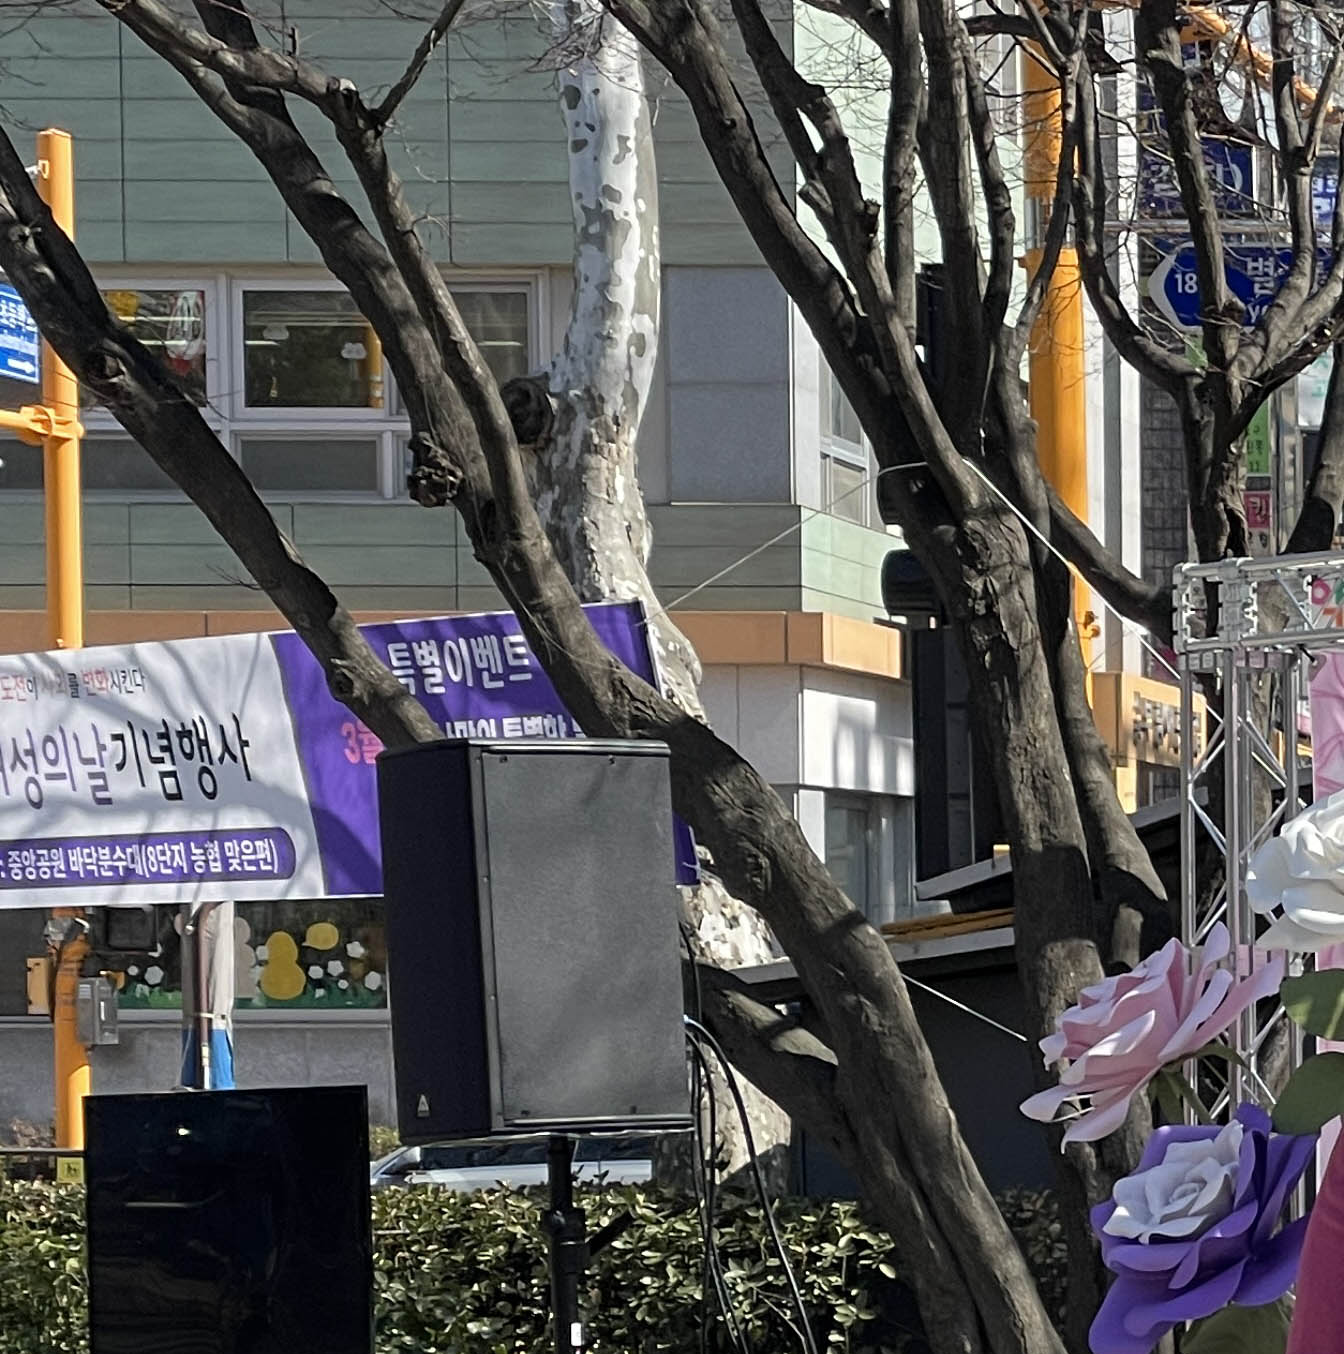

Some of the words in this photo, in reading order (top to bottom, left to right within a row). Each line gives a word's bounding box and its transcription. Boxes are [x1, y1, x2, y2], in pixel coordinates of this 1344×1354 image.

[81, 667, 146, 697] 변화시킨다
[387, 635, 532, 696] 특별이벤트
[8, 848, 67, 881] 중앙공원
[190, 840, 222, 873] 농협
[224, 837, 279, 874] 맞은편)
